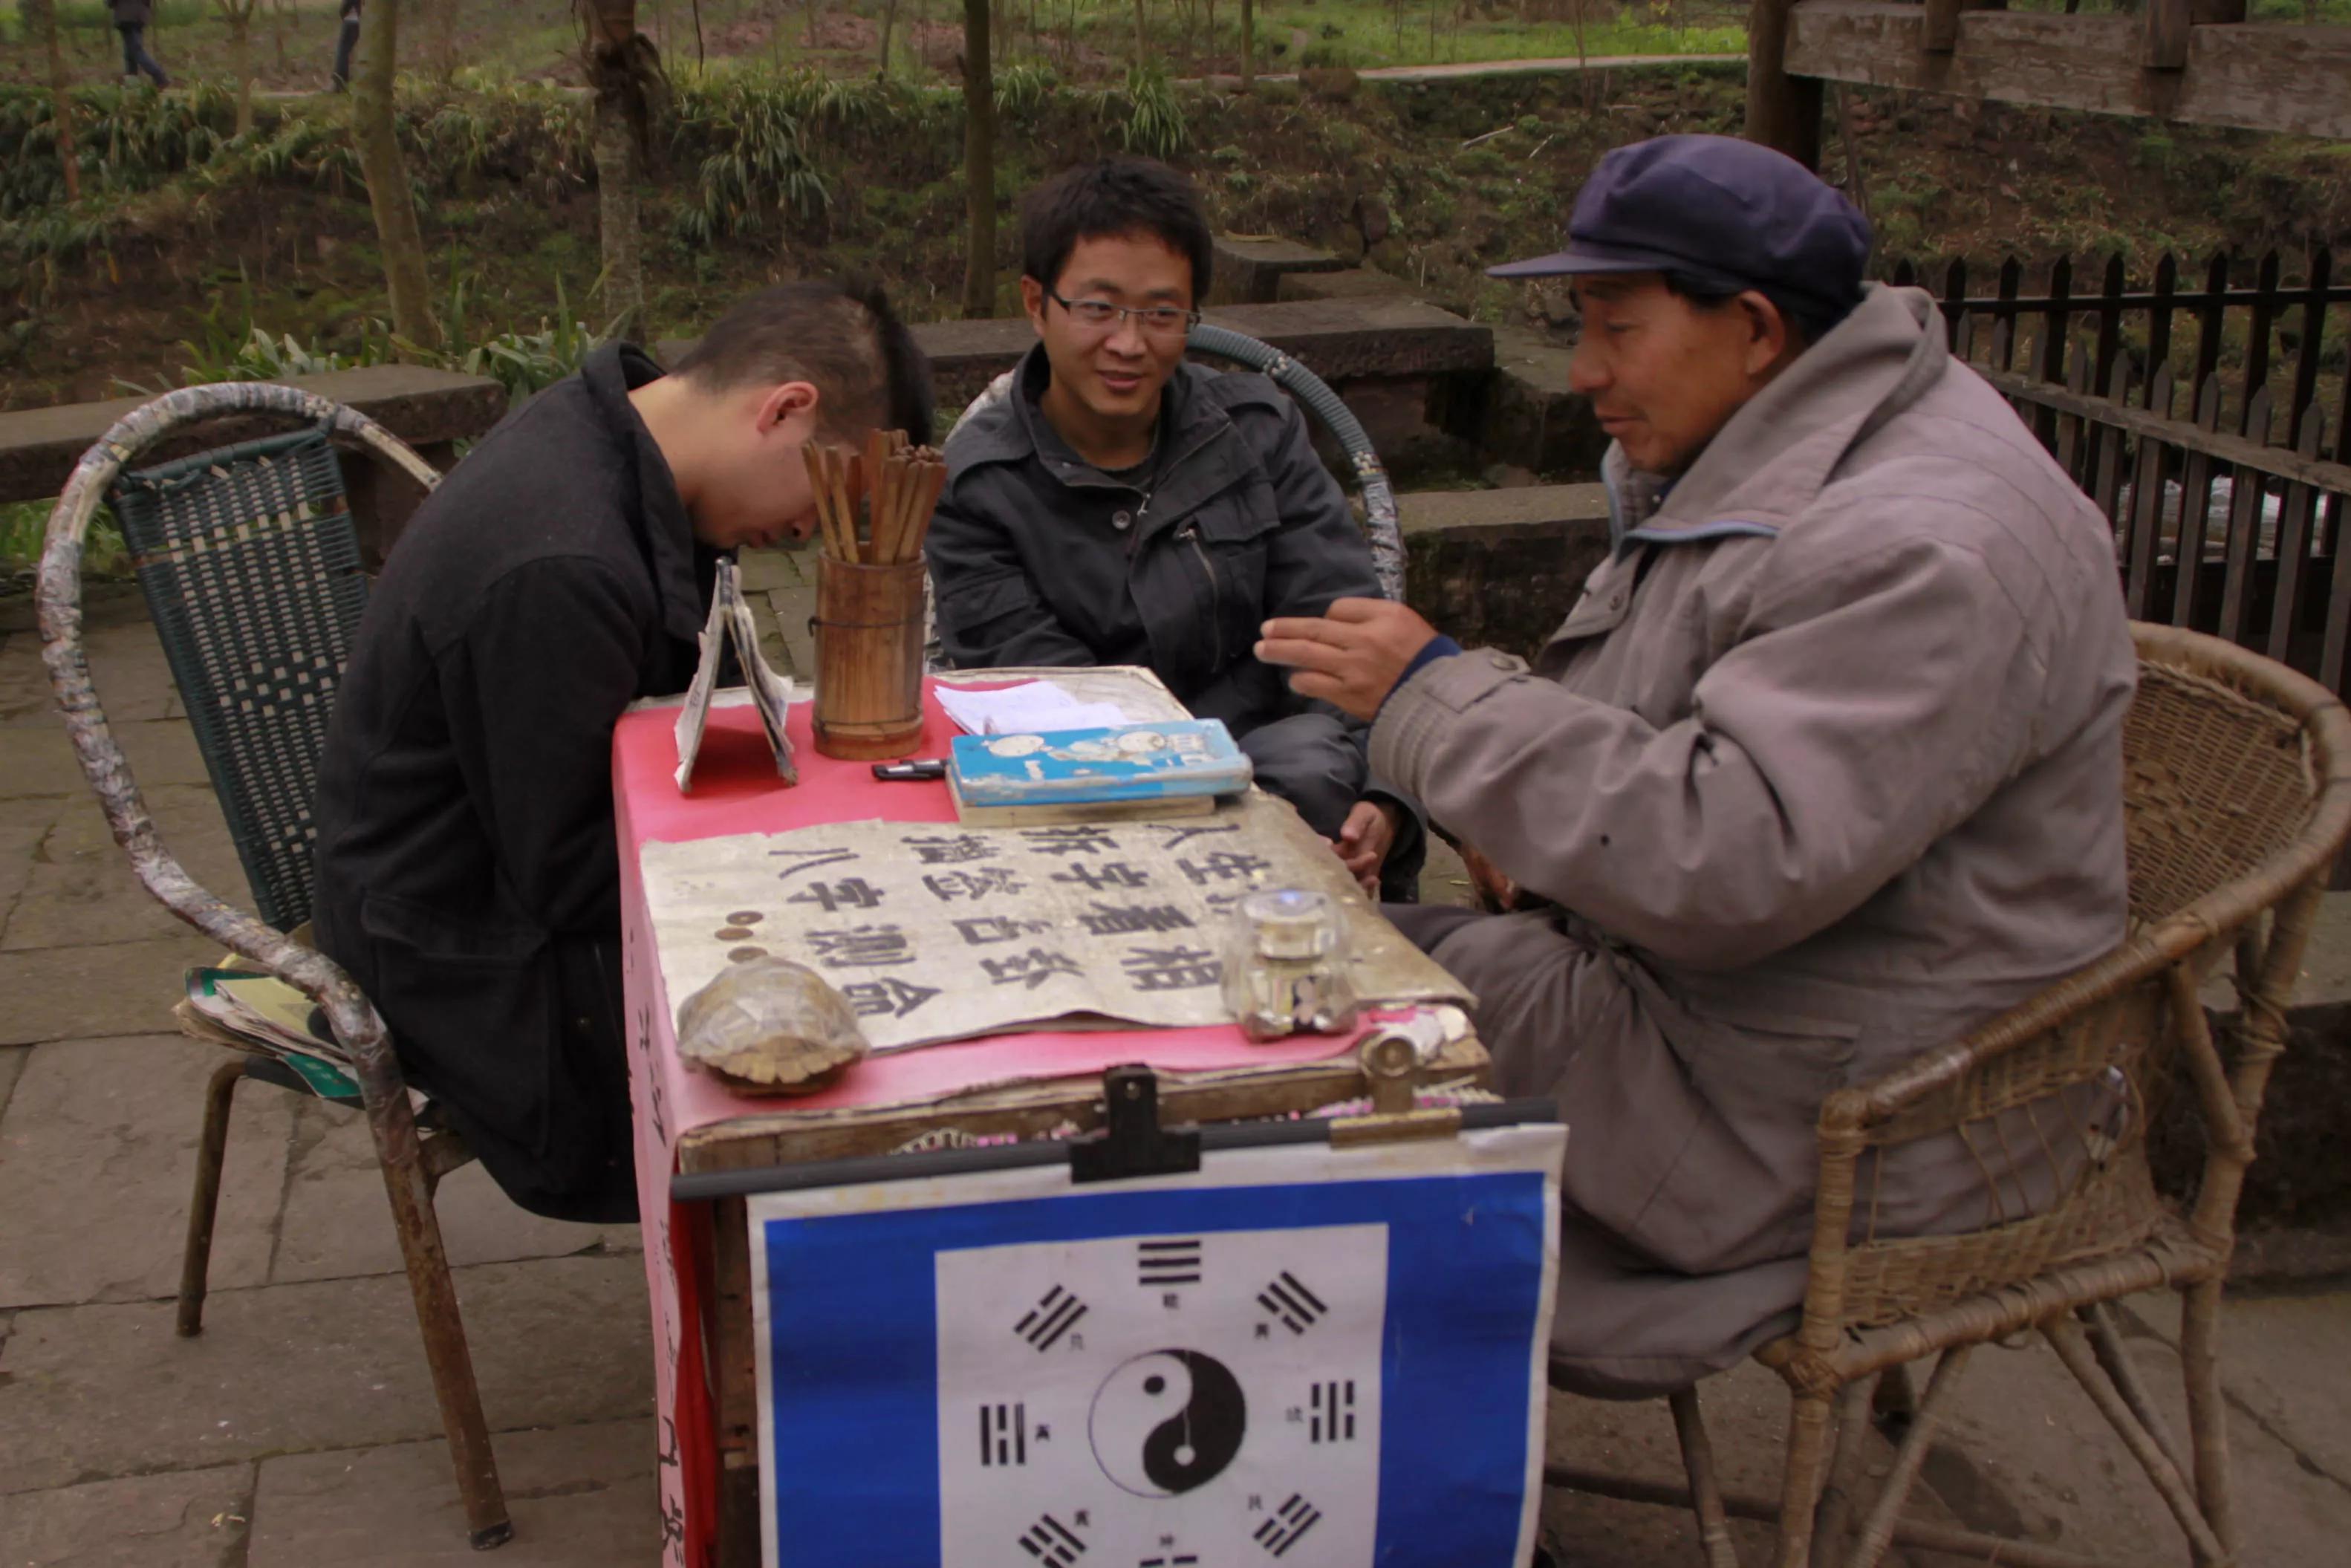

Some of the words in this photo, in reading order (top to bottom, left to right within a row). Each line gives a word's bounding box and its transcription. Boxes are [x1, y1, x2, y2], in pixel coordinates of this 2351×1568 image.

[1018, 825, 1223, 991] 拆字看相
[1144, 823, 1272, 915] 人生
